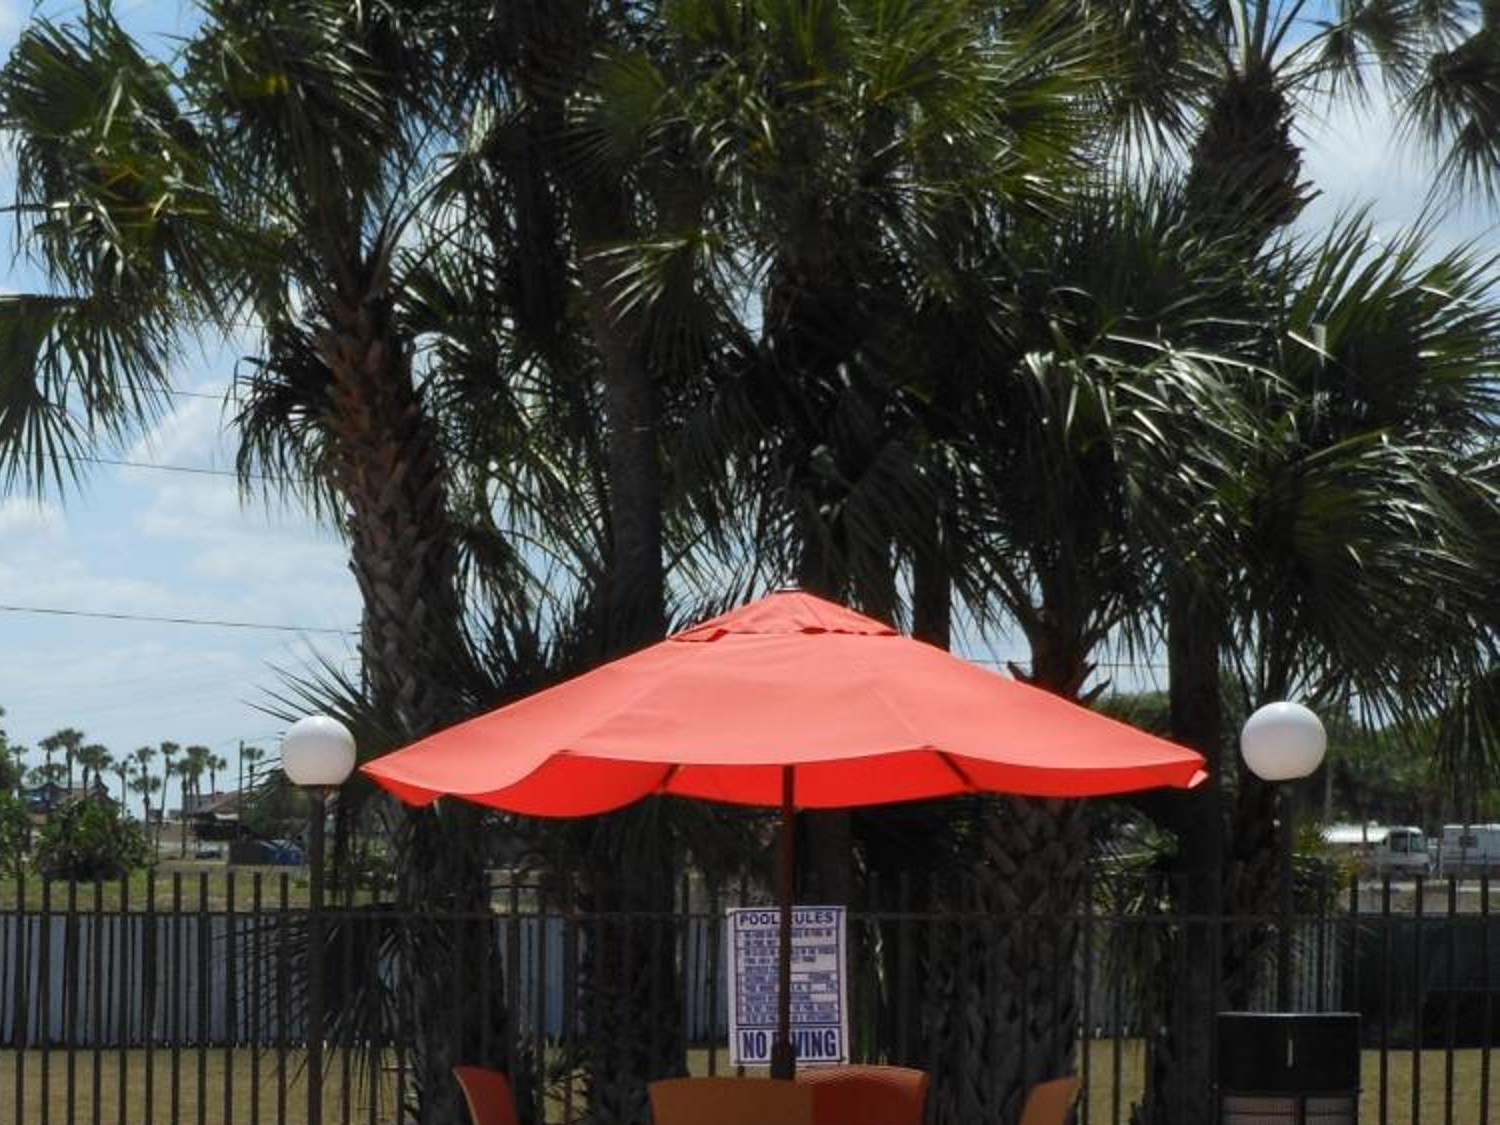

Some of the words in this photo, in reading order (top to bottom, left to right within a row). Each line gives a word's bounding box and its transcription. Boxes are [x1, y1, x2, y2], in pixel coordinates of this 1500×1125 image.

[739, 911, 779, 926] POOL
[792, 910, 835, 925] ULES
[742, 1031, 767, 1059] NO
[772, 1029, 837, 1059] VING
